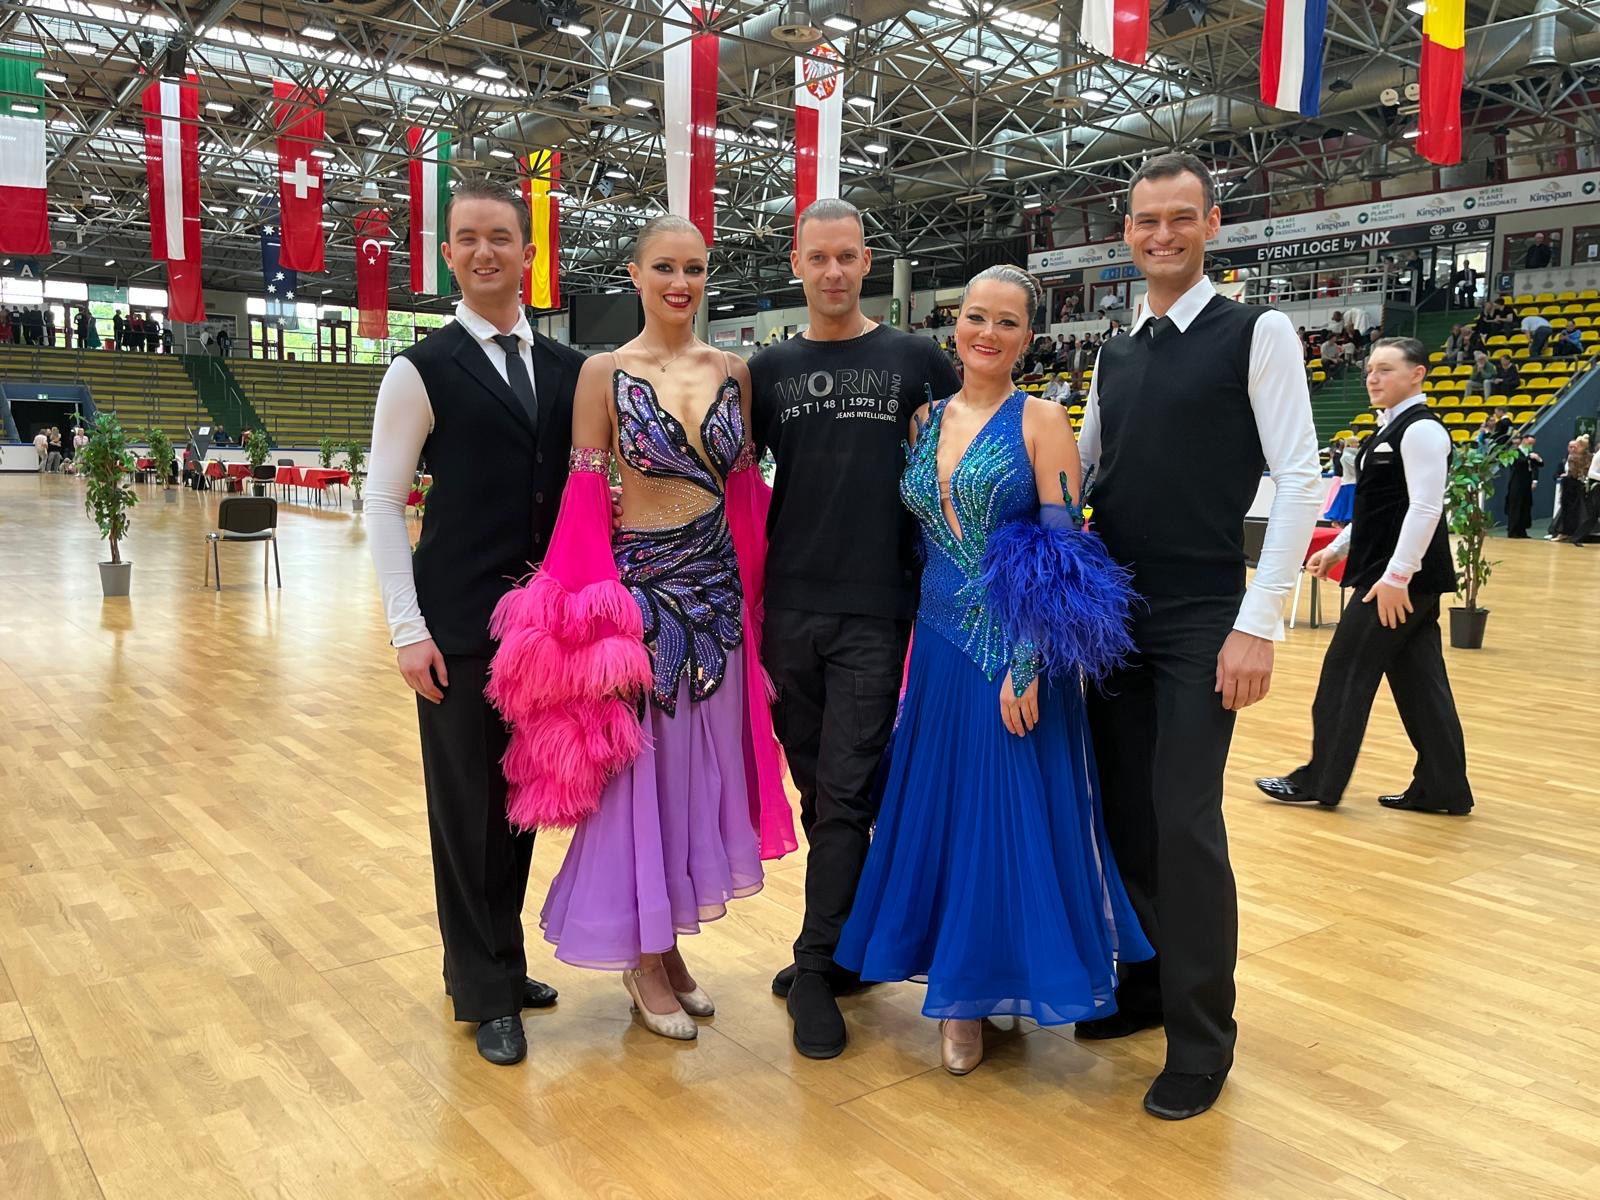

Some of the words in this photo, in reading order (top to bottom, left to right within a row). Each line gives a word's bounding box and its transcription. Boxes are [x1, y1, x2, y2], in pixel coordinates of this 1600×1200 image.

[1530, 191, 1572, 203] Kingspan
[1416, 205, 1455, 217] Kingspan
[1316, 220, 1350, 232] Kingspan
[1227, 233, 1258, 243] Kingspan
[1257, 244, 1300, 260] EVENT
[1302, 239, 1340, 255] LOGE
[1343, 238, 1357, 251] by
[1360, 231, 1390, 247] NIX
[20, 264, 34, 278] A
[1502, 276, 1510, 285] F
[774, 368, 889, 401] WORN
[780, 406, 801, 424] 175
[802, 402, 813, 414] T
[823, 399, 836, 409] 48
[849, 397, 875, 407] 1975
[835, 411, 856, 419] JEANS
[856, 411, 897, 423] INTELLIGENCE
